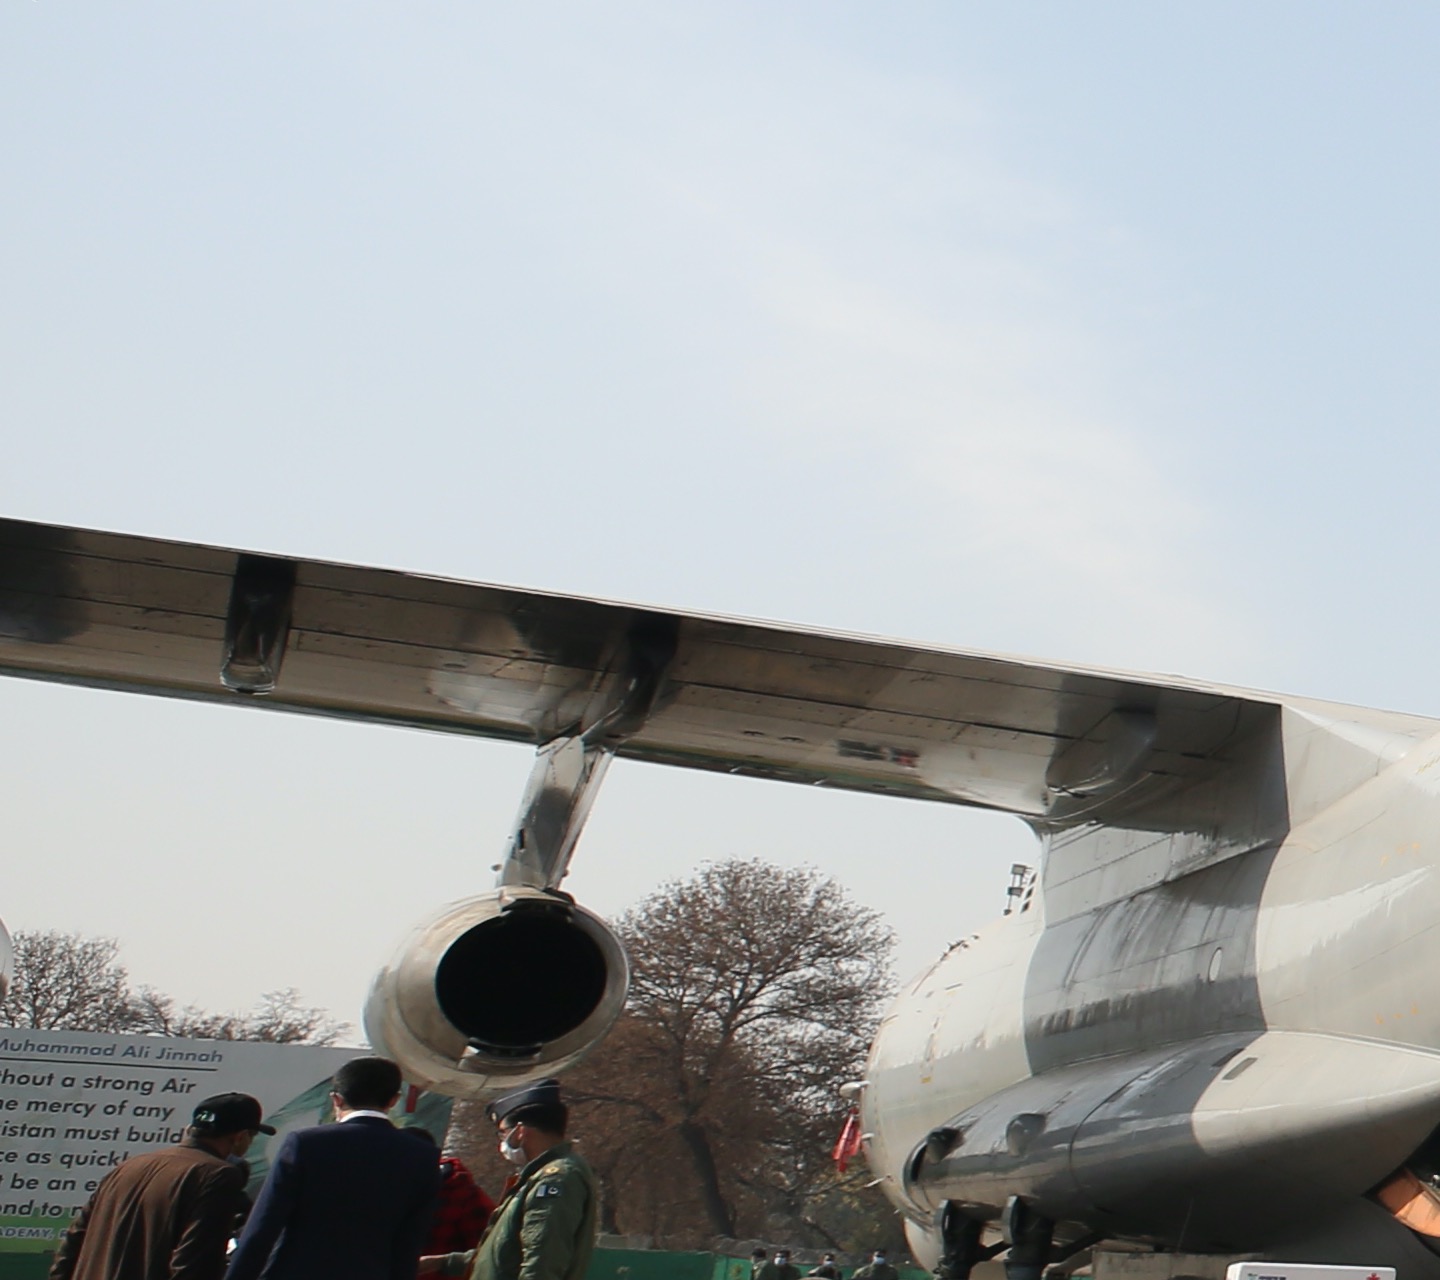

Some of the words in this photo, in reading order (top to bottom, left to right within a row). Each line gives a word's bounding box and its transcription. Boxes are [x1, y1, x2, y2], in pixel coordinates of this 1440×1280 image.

[121, 1045, 151, 1059] Ali
[155, 1048, 224, 1063] Jinnah
[0, 1068, 54, 1087] hout
[61, 1076, 75, 1088] a
[82, 1073, 155, 1096] strong
[161, 1078, 196, 1094] Air
[26, 1099, 97, 1118] mercy
[103, 1100, 129, 1116] of
[133, 1106, 176, 1122] any
[0, 1121, 56, 1139] istan
[64, 1126, 120, 1142] must
[127, 1126, 184, 1144] build
[26, 1151, 52, 1165] as
[10, 1172, 39, 1190] be
[47, 1179, 76, 1191] an
[0, 1200, 34, 1215] nd
[41, 1202, 63, 1217] to
[0, 1227, 54, 1240] DEMY,
